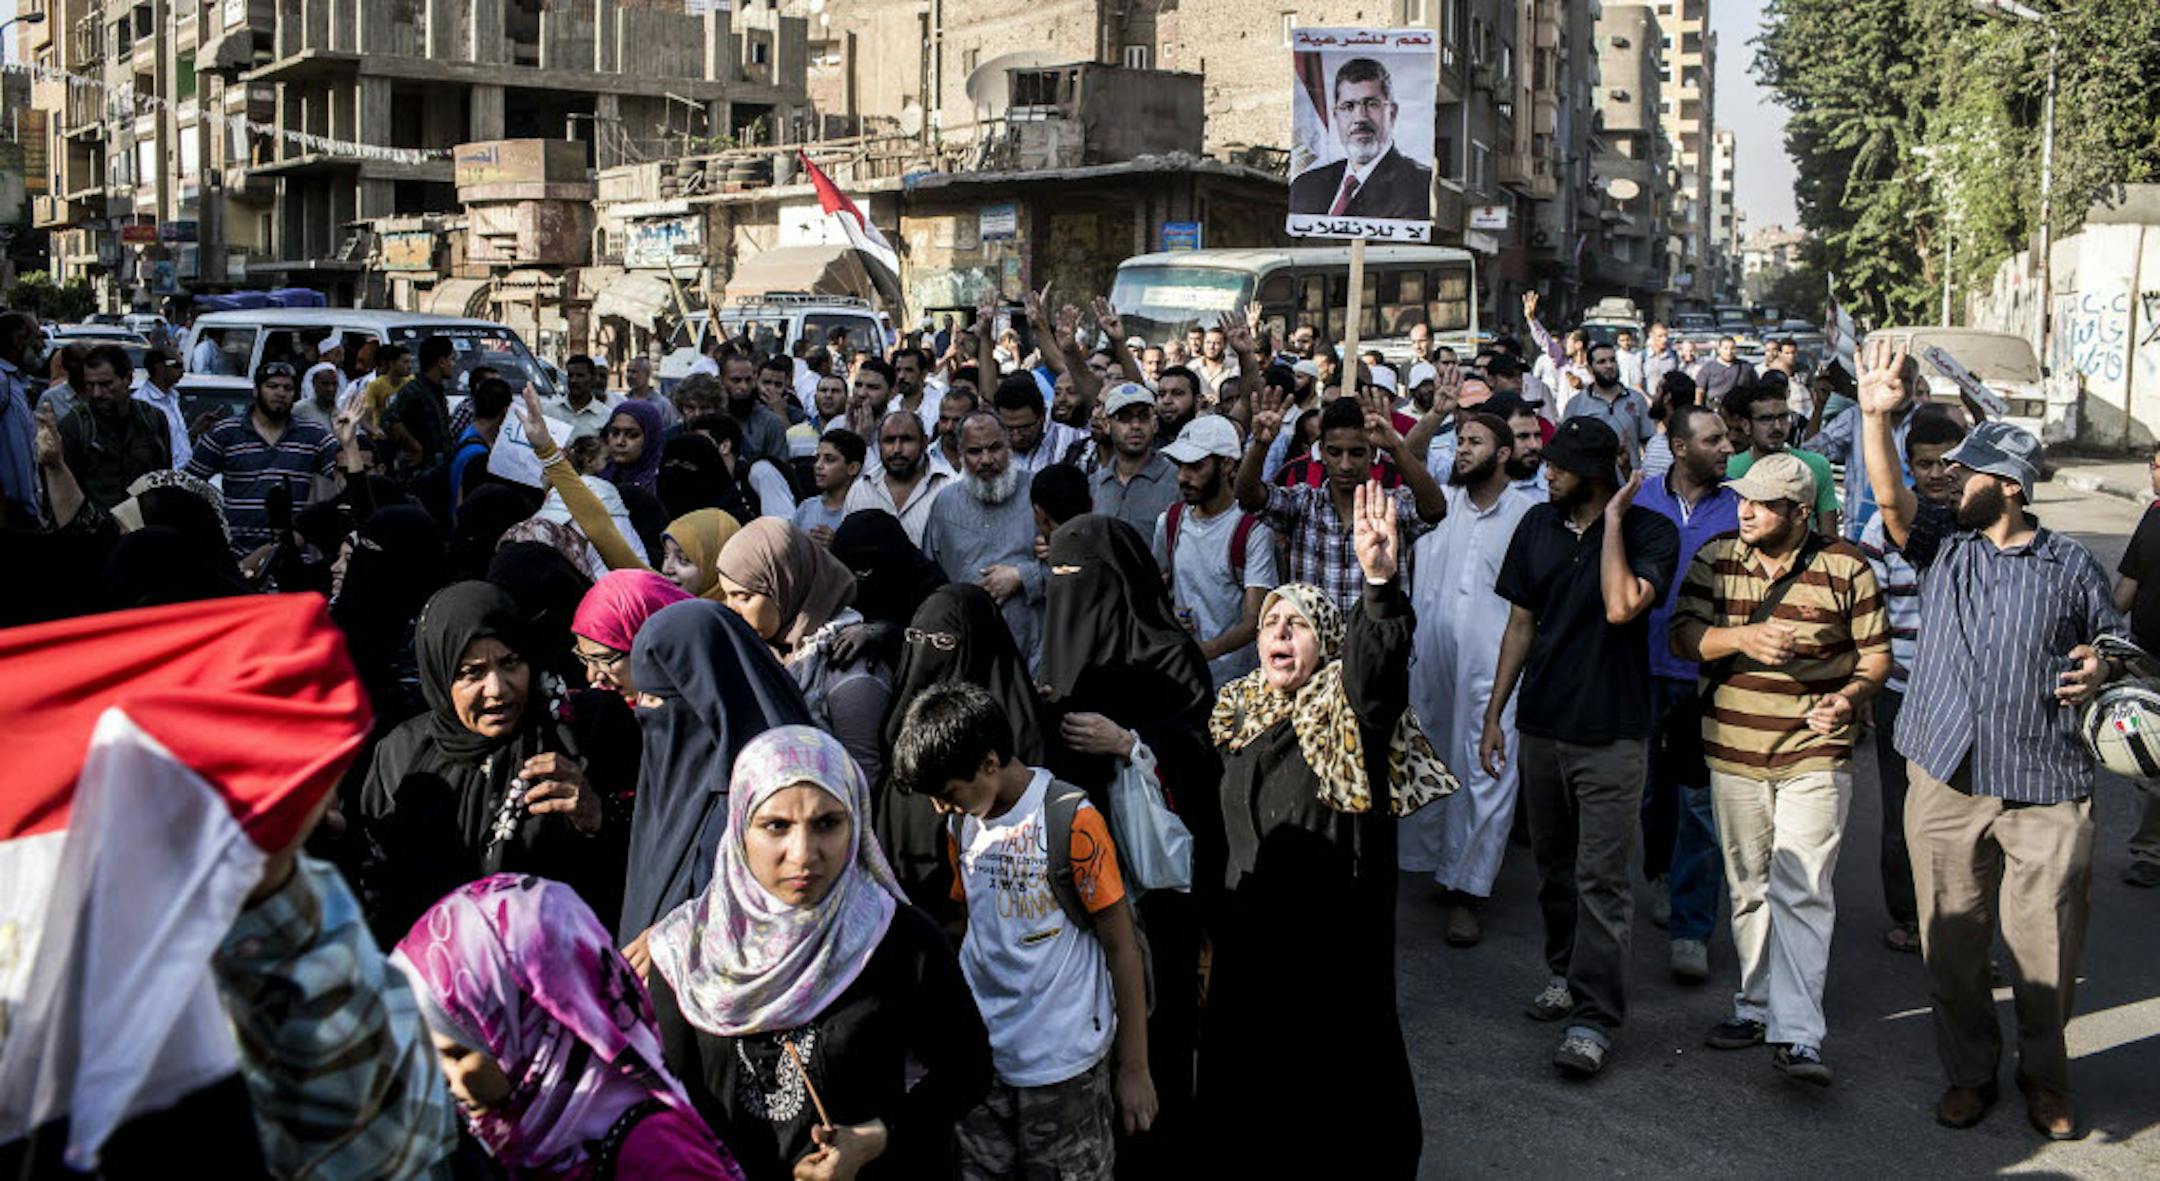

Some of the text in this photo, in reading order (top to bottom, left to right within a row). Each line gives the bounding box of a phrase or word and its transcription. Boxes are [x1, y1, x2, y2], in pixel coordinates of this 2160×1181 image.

[1298, 31, 1432, 48] نعم للشرعية
[1292, 220, 1424, 238] لا للانقلاب
